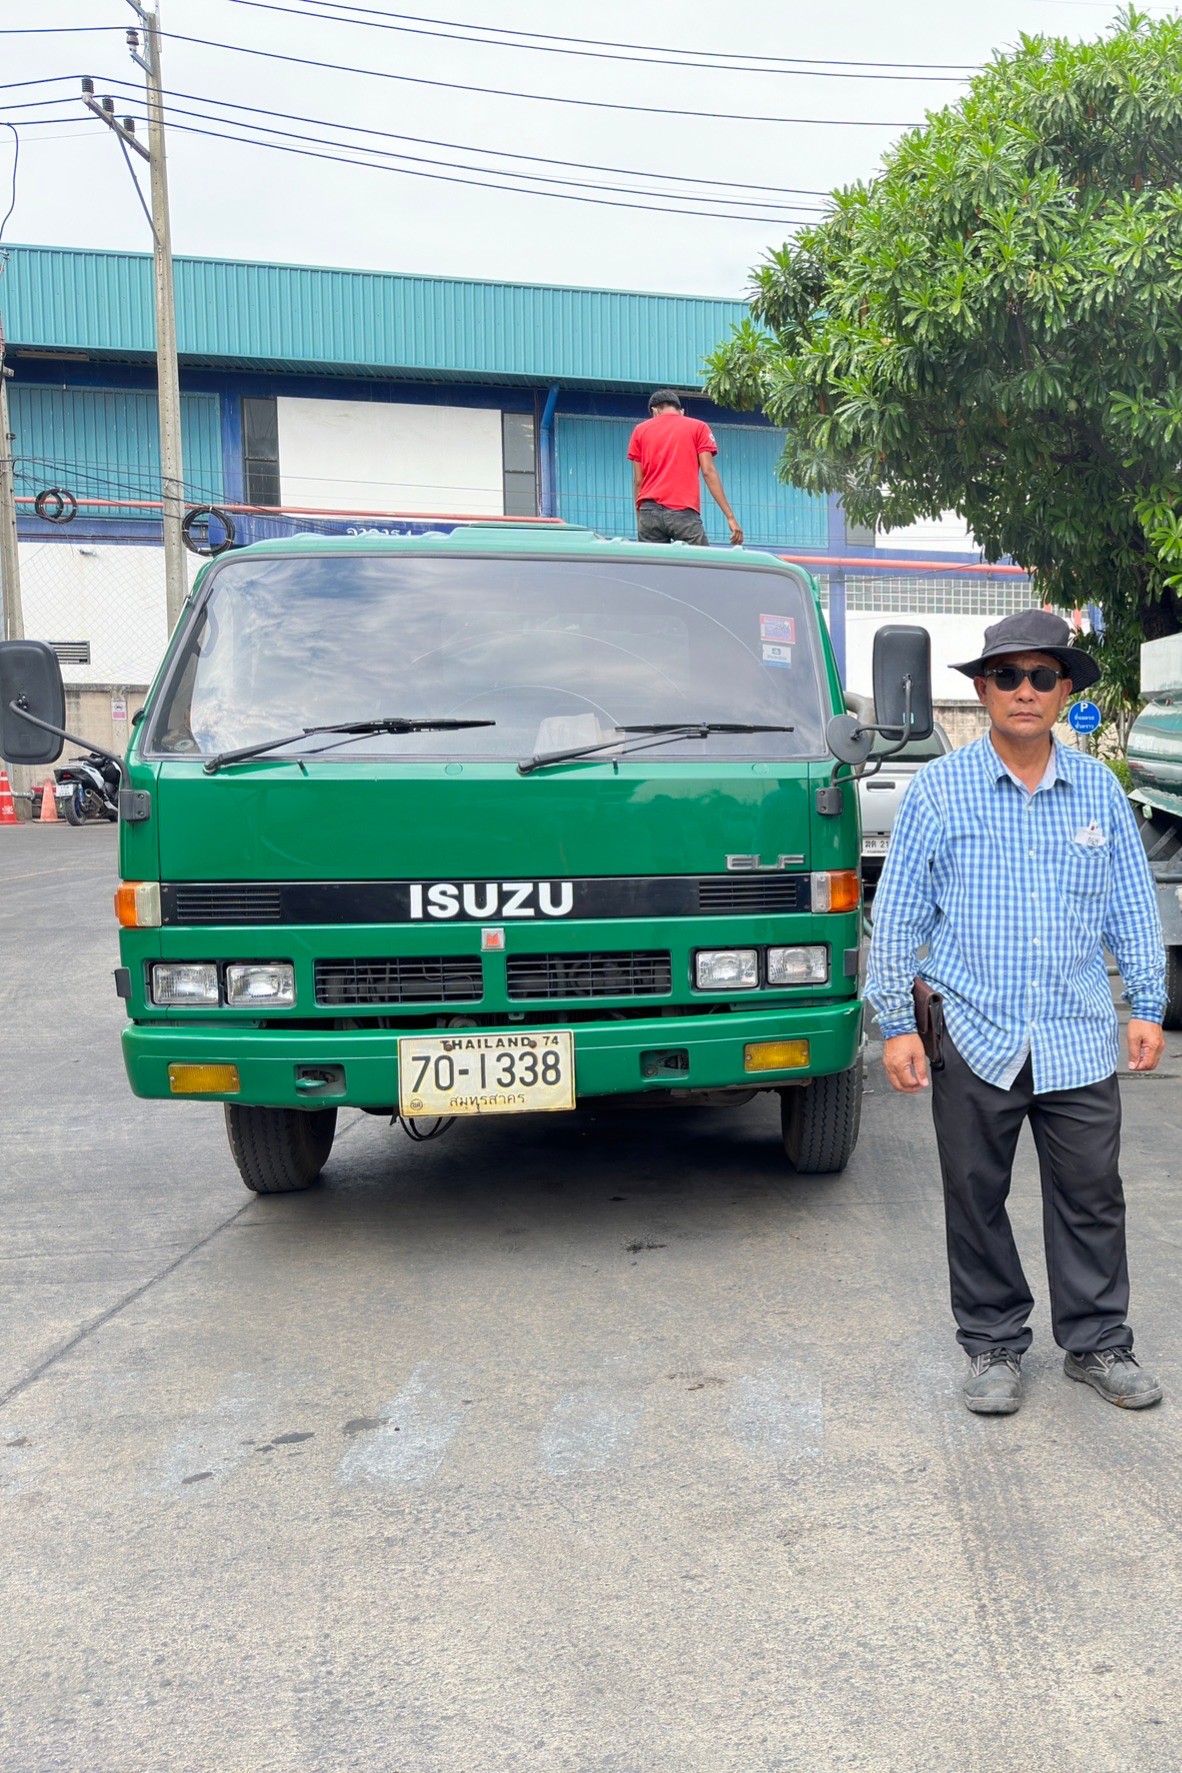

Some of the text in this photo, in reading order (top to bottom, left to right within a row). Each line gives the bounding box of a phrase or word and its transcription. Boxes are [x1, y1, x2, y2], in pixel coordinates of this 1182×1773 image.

[1080, 702, 1089, 713] P
[725, 853, 805, 870] ELF
[410, 882, 574, 919] ISUZU
[440, 1036, 532, 1050] THAILAND
[411, 1049, 562, 1093] 70-1338
